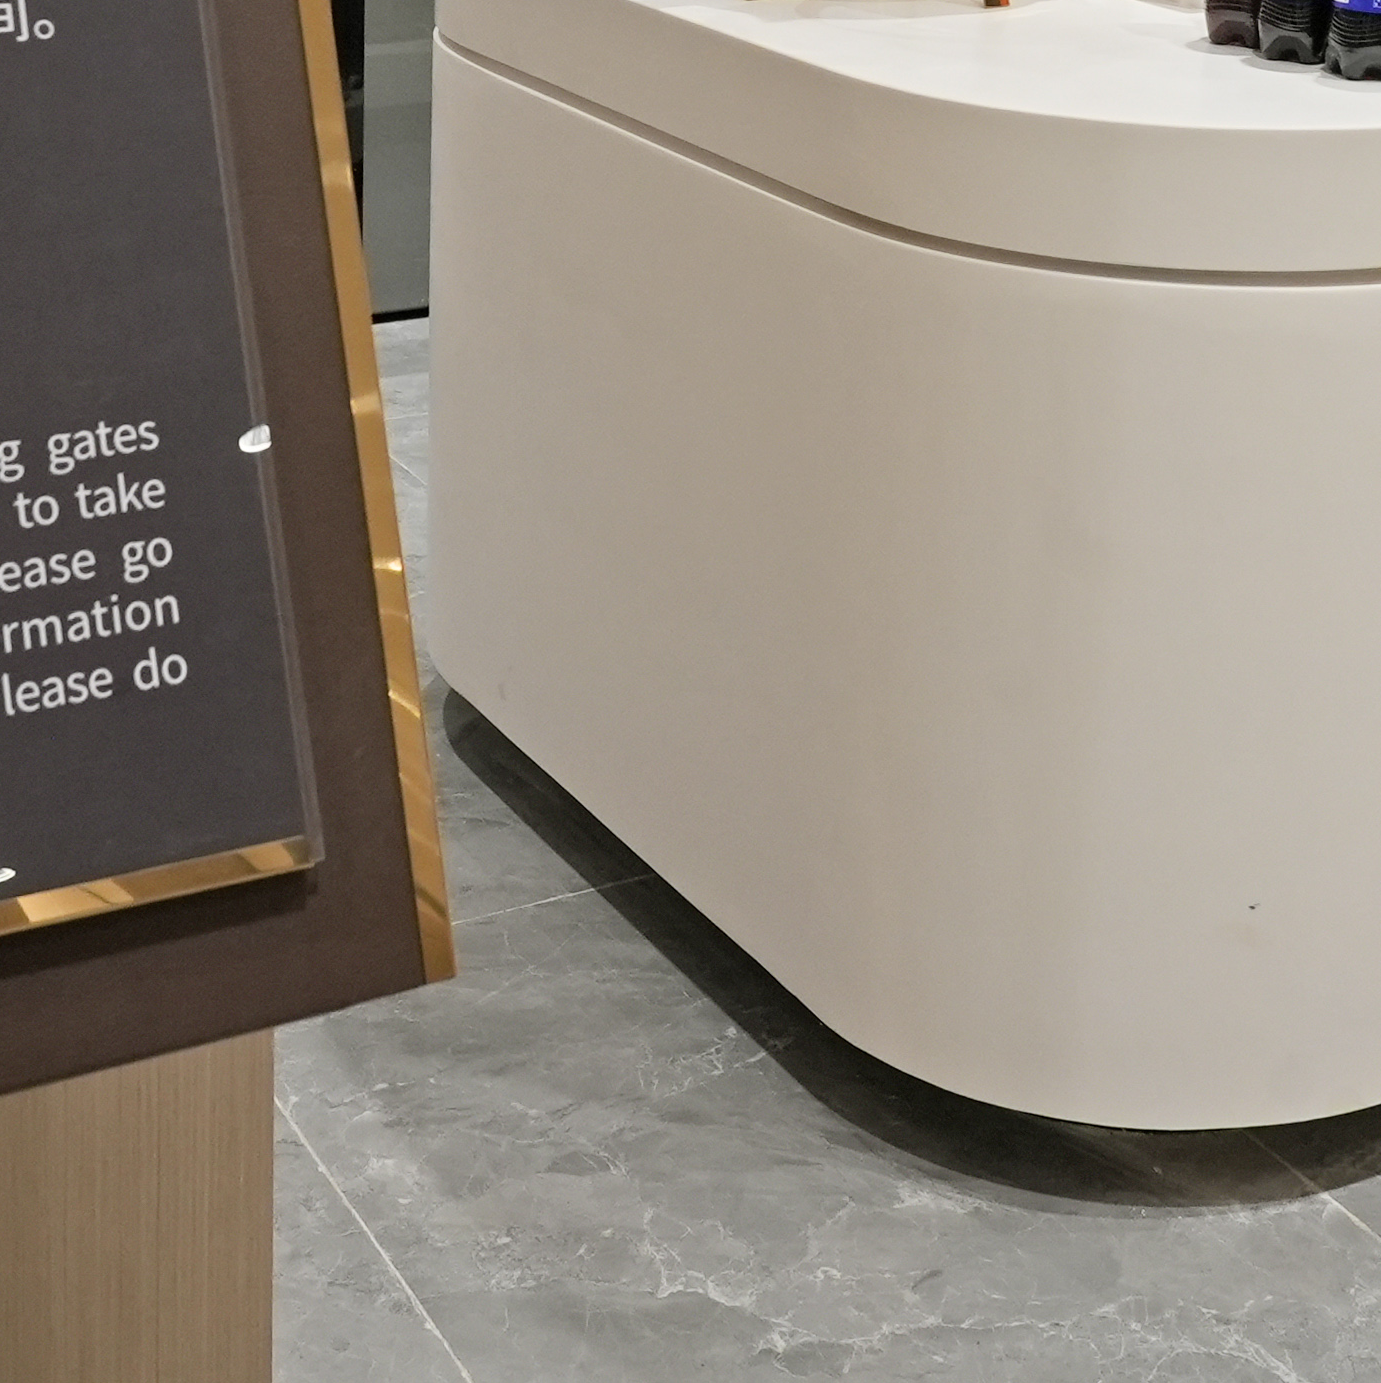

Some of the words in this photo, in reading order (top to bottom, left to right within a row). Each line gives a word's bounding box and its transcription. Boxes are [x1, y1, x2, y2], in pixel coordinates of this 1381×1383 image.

[48, 421, 159, 475] gates
[13, 493, 59, 528] to
[74, 472, 165, 519] take
[122, 537, 172, 583] go
[133, 647, 187, 691] do
